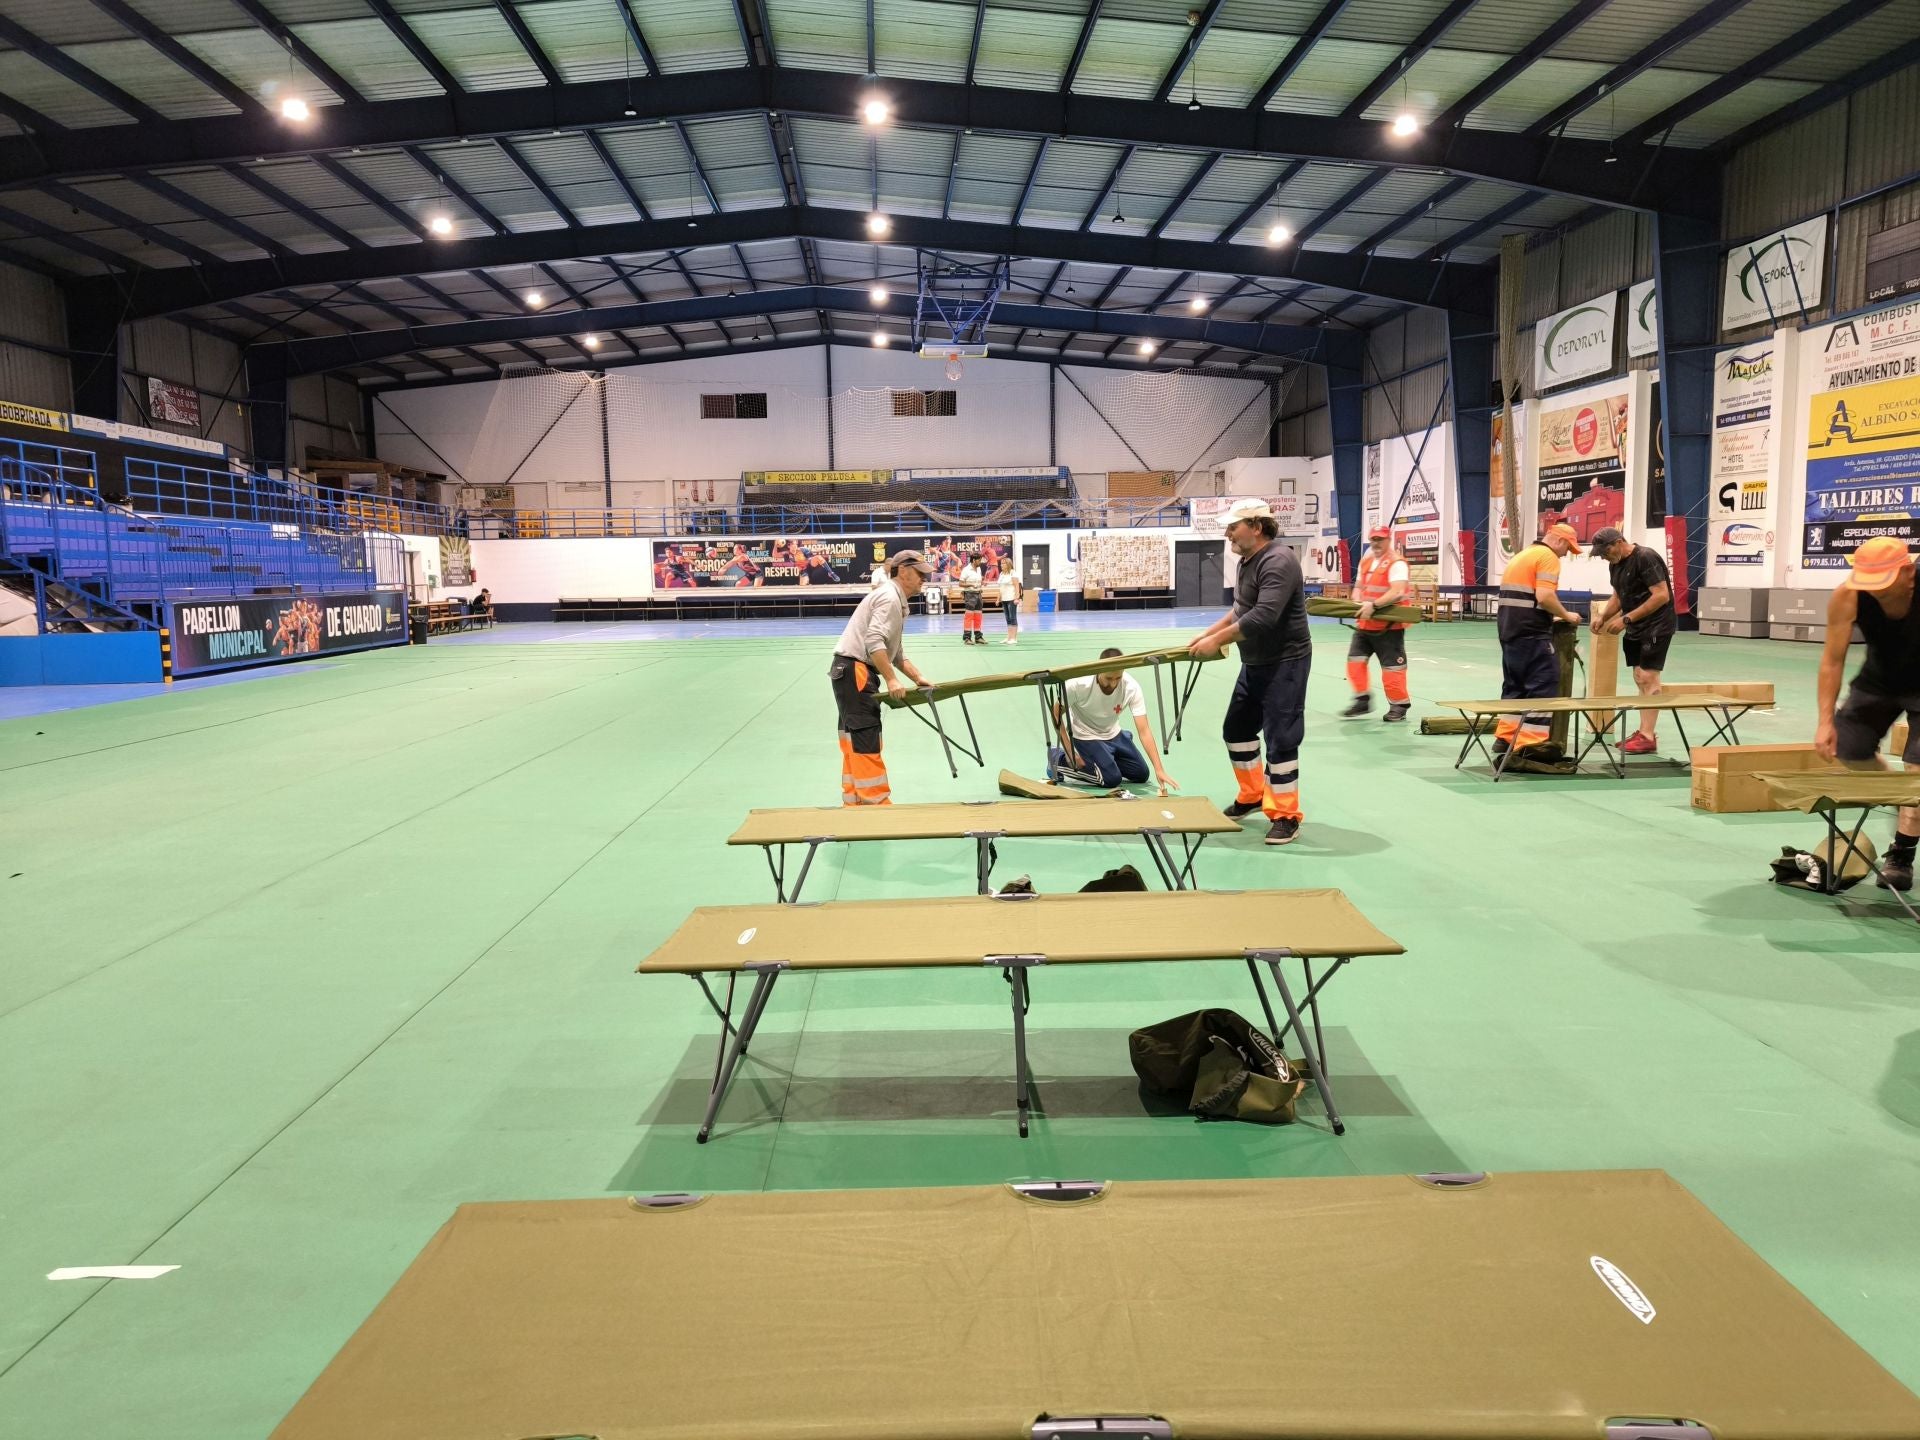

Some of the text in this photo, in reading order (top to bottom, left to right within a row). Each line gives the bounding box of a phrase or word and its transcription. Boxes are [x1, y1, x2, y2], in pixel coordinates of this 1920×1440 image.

[1869, 286, 1896, 299] LOCAL
[1557, 329, 1607, 357] DEPORCYL
[1828, 361, 1901, 389] AYUNTAMIENTO
[1904, 356, 1916, 375] DE
[0, 404, 52, 427] BOBRIGADA
[1860, 411, 1907, 427] ALBINO
[1728, 453, 1744, 464] HOTEL
[778, 472, 856, 482] SECCION PELUSA
[1818, 487, 1904, 509] TALLERES
[1407, 534, 1437, 542] SANTILLANA
[1843, 528, 1887, 537] ESPECIALISTAS
[1887, 527, 1896, 535] EN
[803, 541, 856, 555] MOTIVACIÓN
[957, 542, 983, 552] RESPET
[688, 559, 727, 572] LOGROS
[1810, 557, 1844, 567] 979.85.12.41
[765, 566, 800, 577] RESPETO
[182, 605, 241, 635] PABELLON
[326, 604, 382, 638] DE GUARDO
[209, 629, 267, 660] MUNICIPAL
